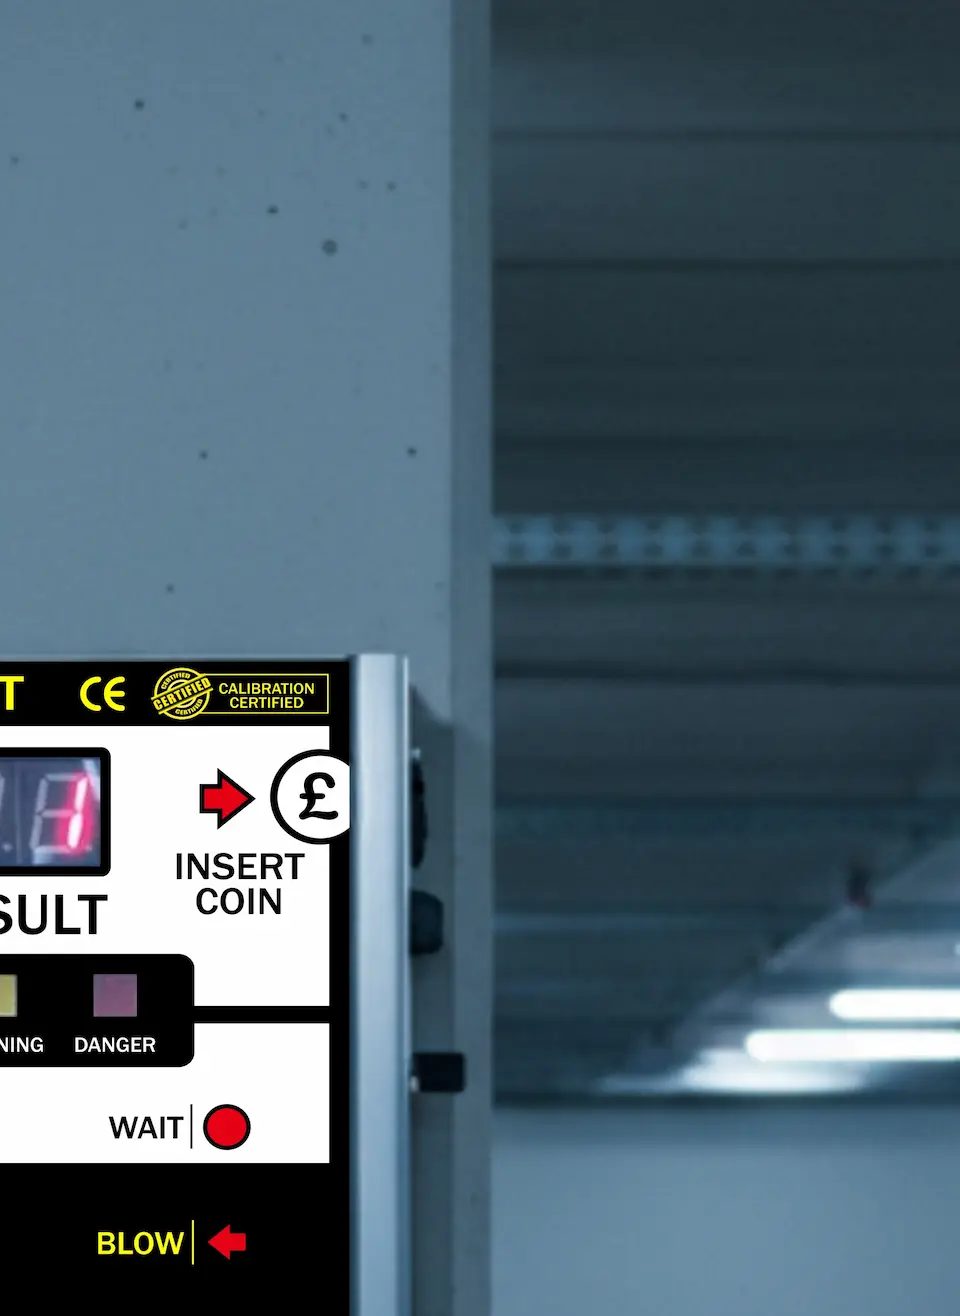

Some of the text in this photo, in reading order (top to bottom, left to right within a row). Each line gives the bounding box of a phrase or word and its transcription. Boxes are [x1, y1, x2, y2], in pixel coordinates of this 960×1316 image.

[153, 677, 211, 711] CERTIFIED
[219, 683, 314, 694] CALIBRATION
[230, 697, 304, 708] CERTIFIED
[298, 771, 339, 821] £
[176, 852, 306, 881] INSERT
[195, 887, 282, 916] COIN
[74, 1036, 156, 1053] DANGER
[108, 1116, 185, 1140] WAIT
[97, 1231, 185, 1256] BLOW
